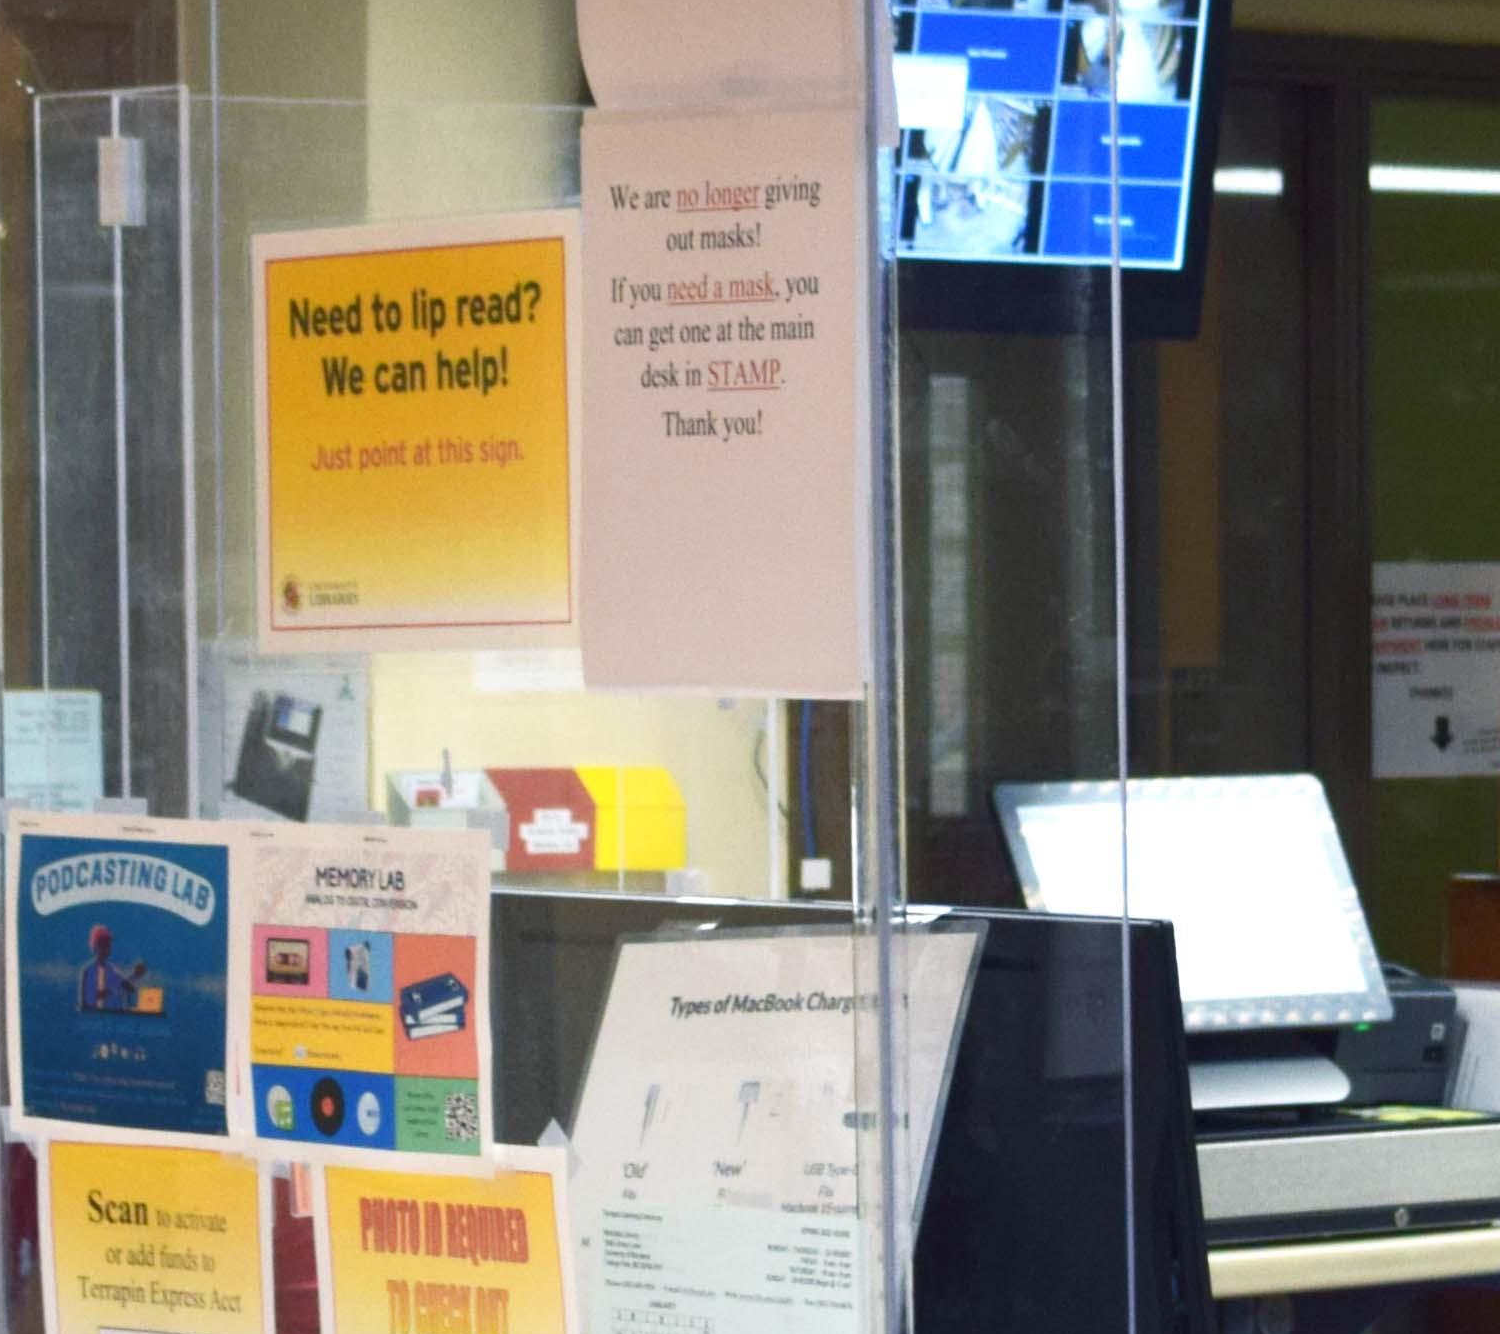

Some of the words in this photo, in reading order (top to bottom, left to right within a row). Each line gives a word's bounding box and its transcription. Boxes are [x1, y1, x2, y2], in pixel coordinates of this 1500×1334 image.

[611, 185, 639, 210] We
[645, 189, 670, 209] are
[676, 187, 699, 210] no
[706, 180, 761, 210] longer
[765, 175, 821, 210] giving
[667, 230, 695, 251] out
[700, 222, 761, 249] masks!
[612, 276, 627, 303] If
[630, 284, 661, 309] you
[668, 274, 707, 302] need
[713, 284, 722, 300] a
[785, 275, 819, 302] you
[288, 294, 362, 339] Need
[372, 293, 402, 332] to
[412, 288, 446, 337] lip
[456, 280, 542, 327] read?
[614, 326, 643, 346] can
[649, 322, 675, 350] get
[680, 322, 710, 343] one
[716, 321, 733, 341] at
[738, 316, 765, 340] the
[771, 313, 814, 339] main
[322, 355, 364, 396] We
[373, 357, 427, 394] can
[436, 346, 508, 396] help!
[641, 364, 678, 388] desk
[685, 361, 702, 386] in
[707, 358, 786, 389] STAMP.
[662, 410, 717, 437] Thank
[724, 409, 763, 442] you!
[310, 446, 352, 470] Just
[359, 441, 406, 470] point
[413, 440, 432, 466] at
[437, 438, 474, 464] this
[480, 436, 524, 468] sign.
[35, 858, 166, 902] PODCASTING
[172, 872, 209, 911] LAB
[315, 867, 375, 889] MEMORY
[379, 871, 404, 891] LAB
[671, 996, 710, 1019] Types
[713, 995, 731, 1013] of
[732, 993, 802, 1014] MacBook
[87, 1188, 148, 1226] Scan
[156, 1209, 172, 1227] to
[175, 1206, 227, 1233] activate
[359, 1196, 420, 1255] PHOTO
[424, 1201, 443, 1257] ID
[446, 1202, 529, 1267] REQUIRED
[105, 1246, 122, 1265] or
[127, 1243, 155, 1268] add
[159, 1244, 198, 1271] funds
[201, 1253, 215, 1272] to
[76, 1275, 146, 1308] Terrapin
[150, 1281, 206, 1313] Express
[210, 1287, 242, 1314] Acct
